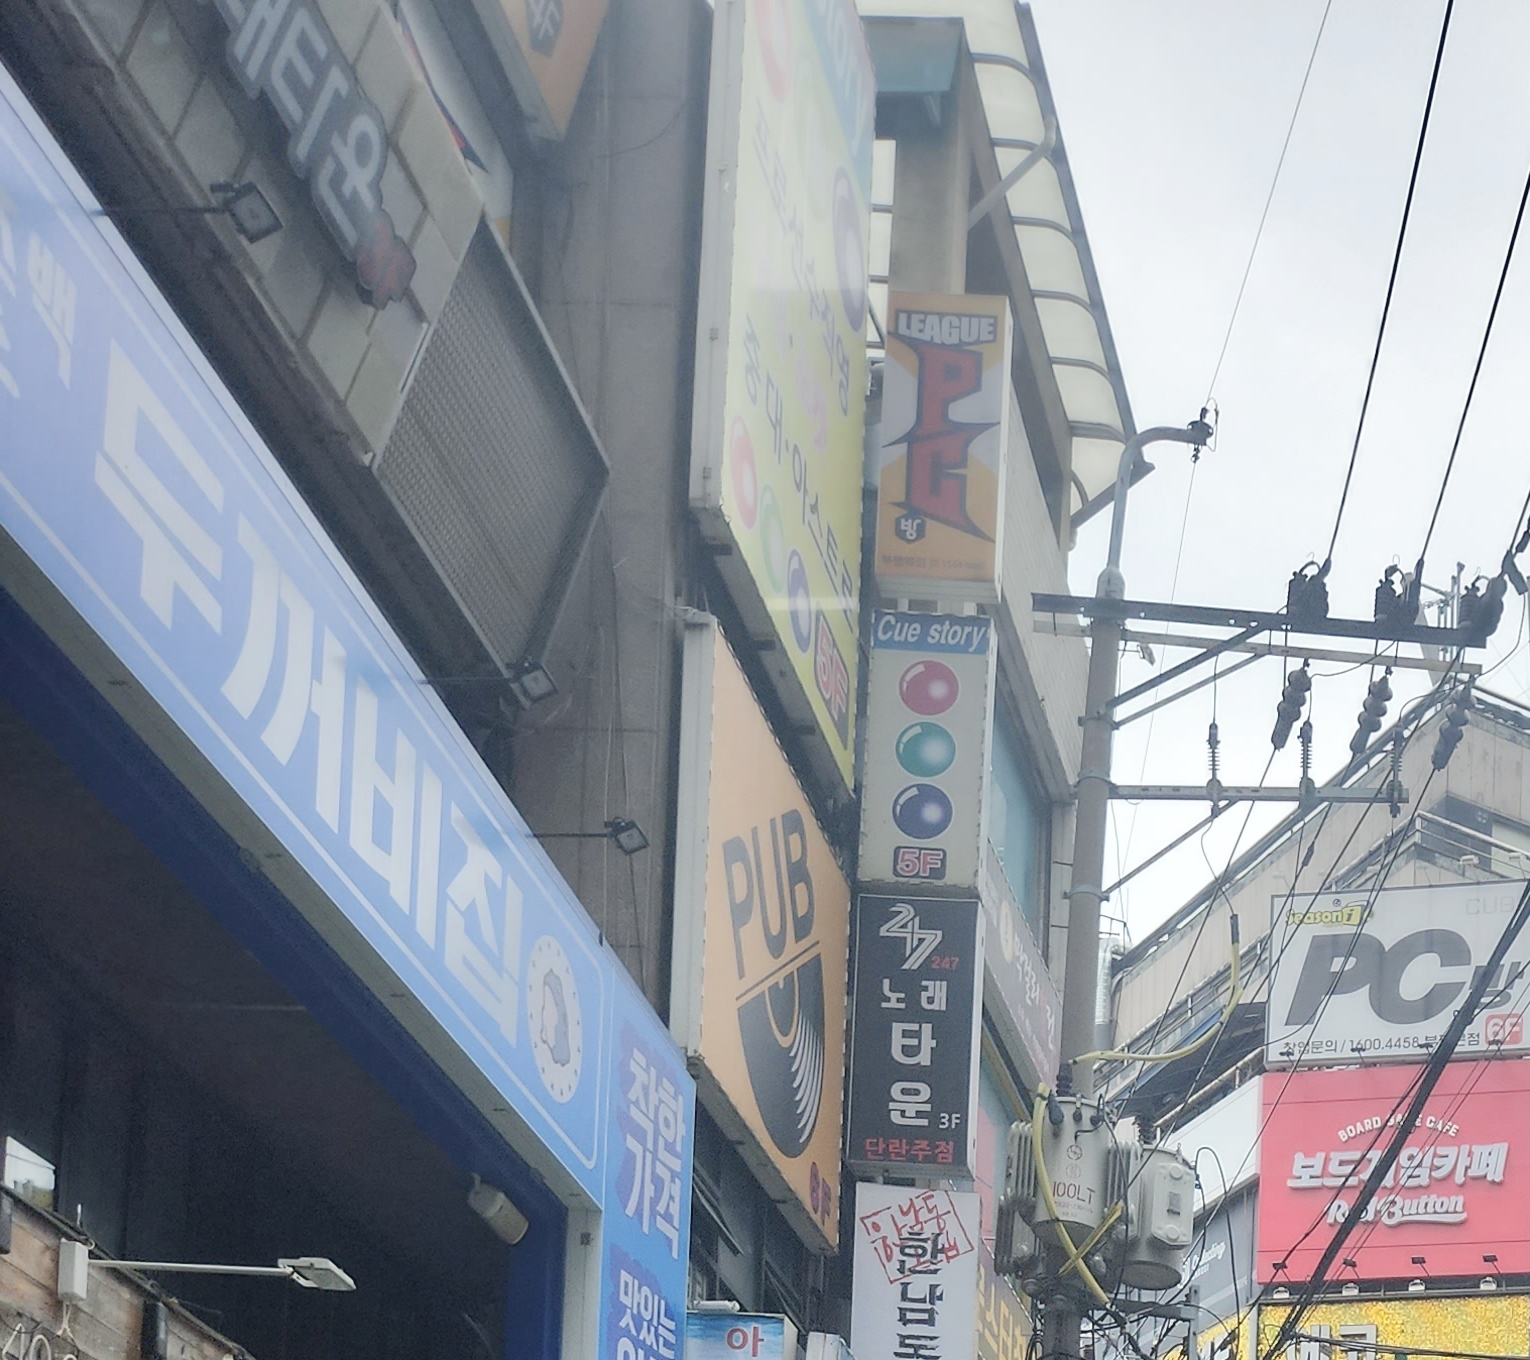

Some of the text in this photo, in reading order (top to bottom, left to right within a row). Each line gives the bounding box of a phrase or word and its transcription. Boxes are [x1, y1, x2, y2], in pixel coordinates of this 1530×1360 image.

[898, 311, 997, 345] LEAGUE
[877, 614, 991, 656] Cue story
[95, 340, 525, 1035] 두꺼비집
[896, 848, 943, 877] 5F
[721, 807, 817, 982] PUB
[930, 954, 961, 970] 247
[1284, 928, 1474, 1028] PC
[879, 979, 949, 1128] 노래타운
[626, 1046, 688, 1152] 착한
[938, 1112, 962, 1130] 3F
[1338, 1115, 1461, 1143] BOARD CAFE
[864, 1137, 955, 1163] 단란주점
[623, 1135, 684, 1262] 가격
